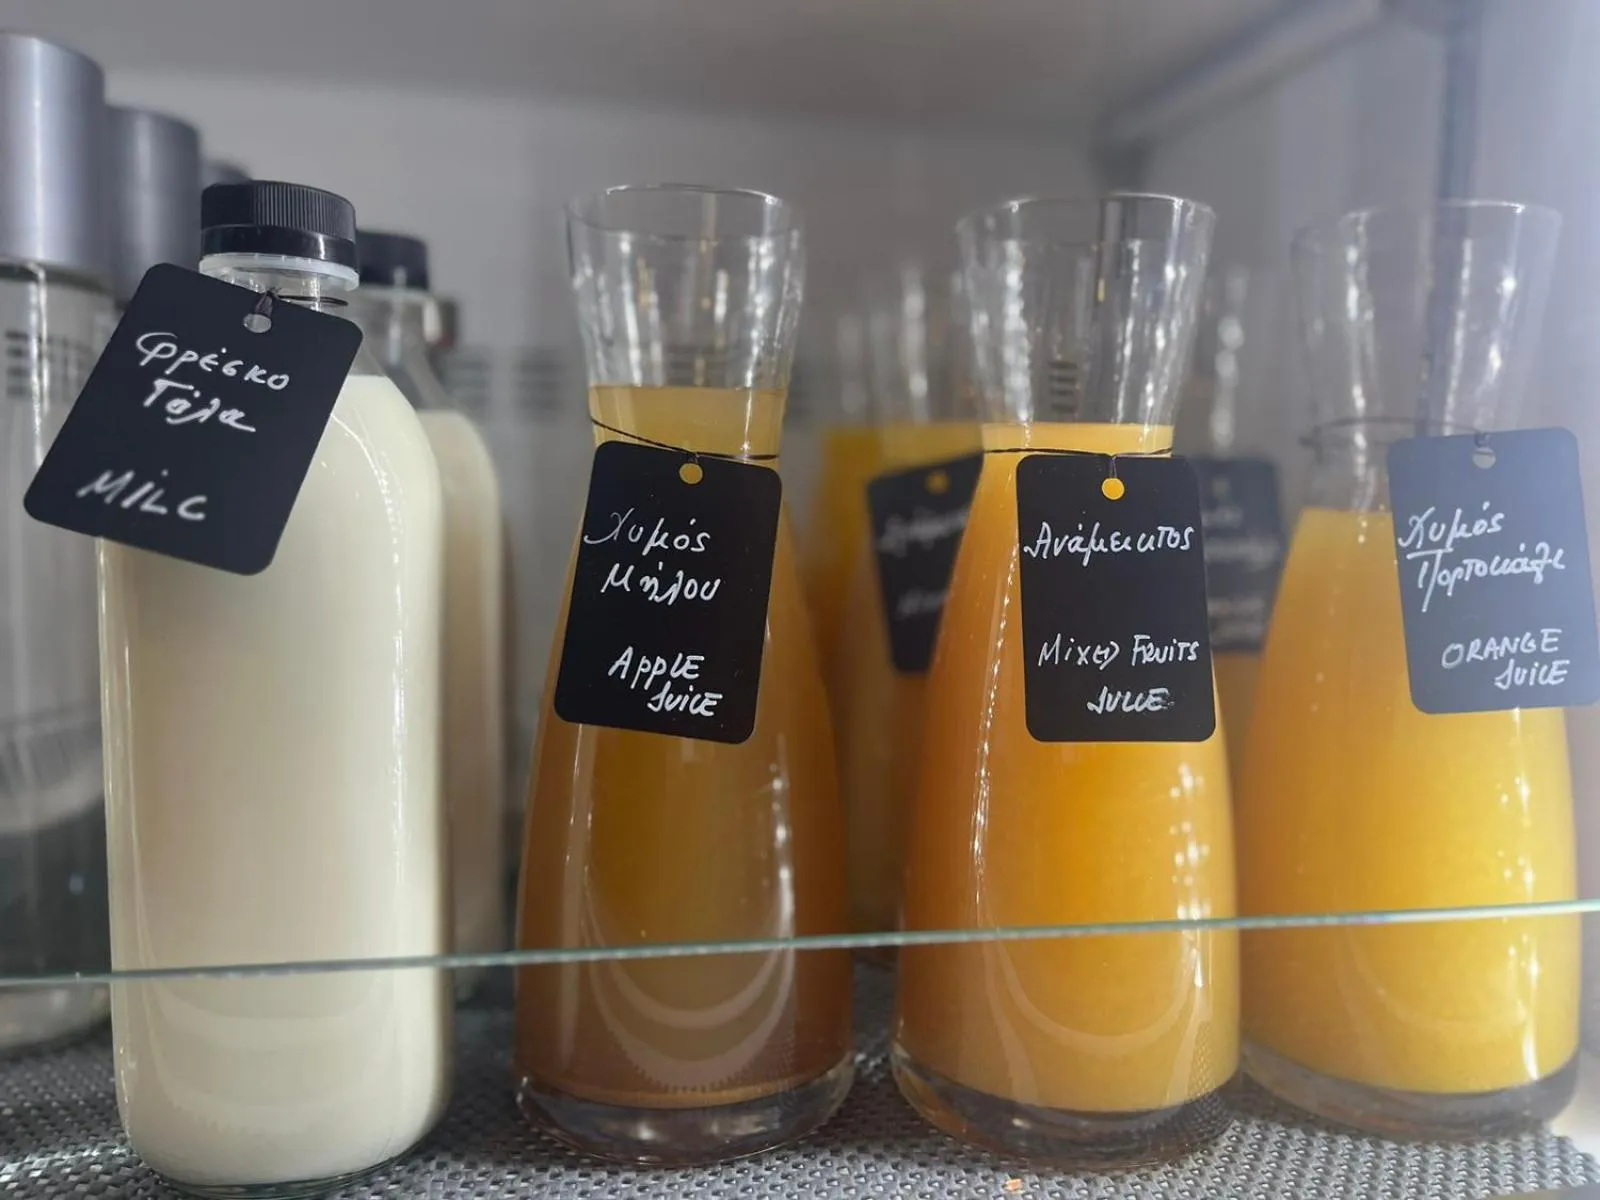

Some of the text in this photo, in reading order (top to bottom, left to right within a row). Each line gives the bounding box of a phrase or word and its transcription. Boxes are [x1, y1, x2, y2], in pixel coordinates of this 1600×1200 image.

[583, 507, 711, 556] Χυμός
[1397, 501, 1505, 549] Χυμός
[1441, 628, 1563, 670] ORANGE
